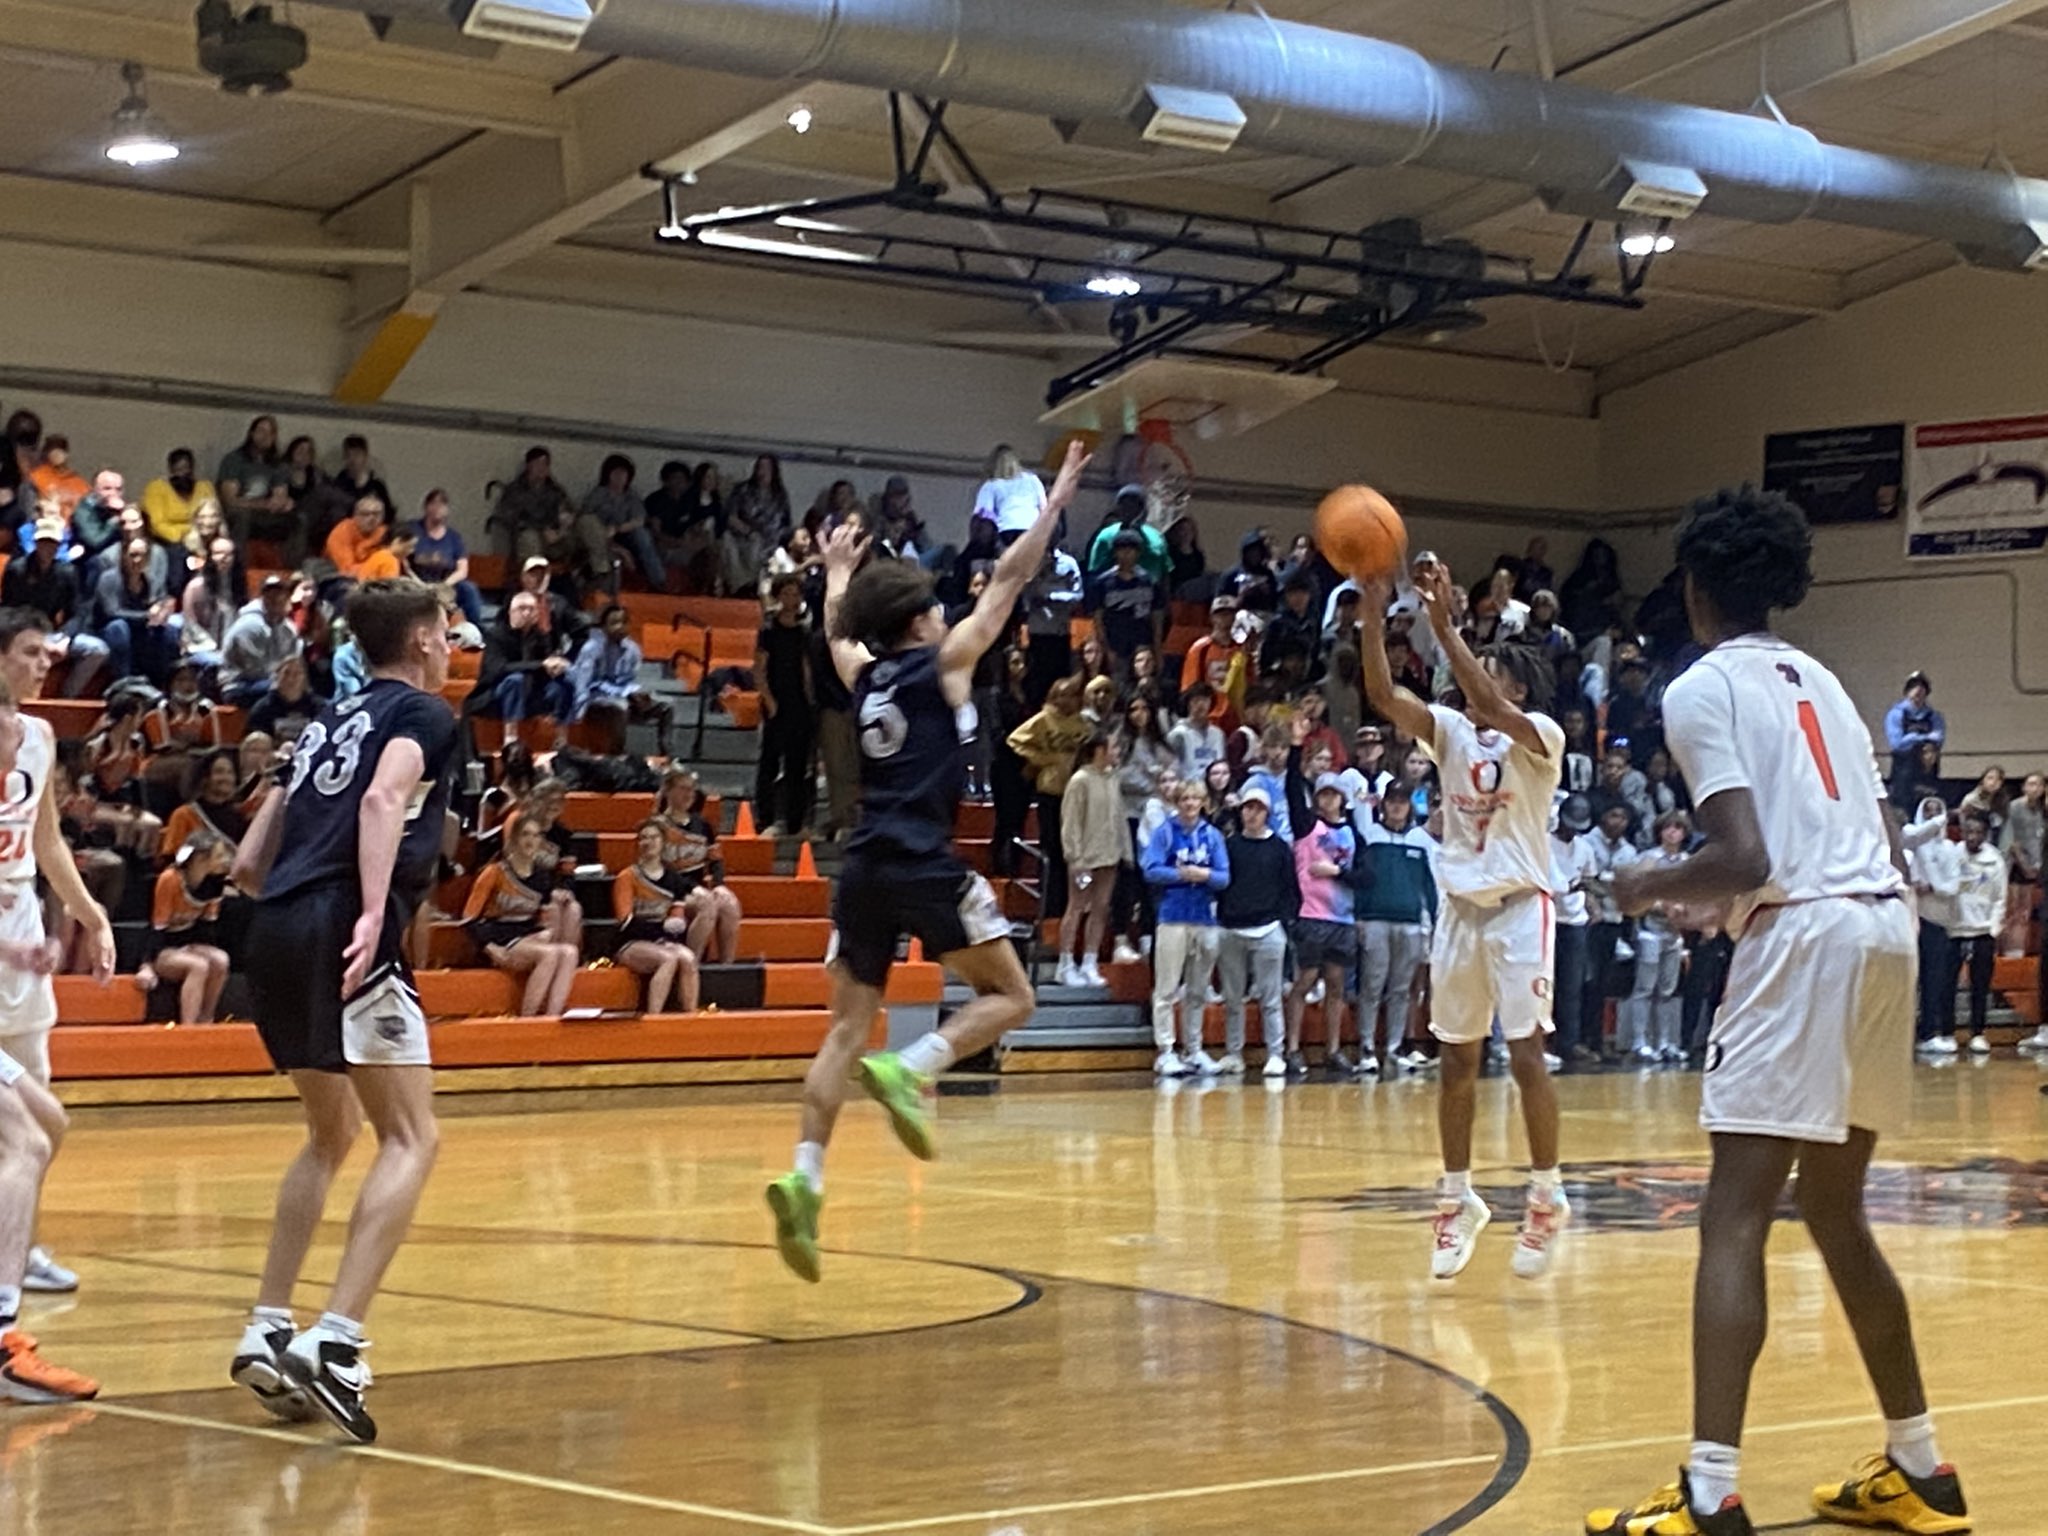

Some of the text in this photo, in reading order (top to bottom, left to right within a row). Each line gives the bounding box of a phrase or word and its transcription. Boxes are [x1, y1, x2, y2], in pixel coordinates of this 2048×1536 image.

[285, 710, 375, 805] 33
[859, 684, 909, 760] 5
[1797, 699, 1841, 801] 1
